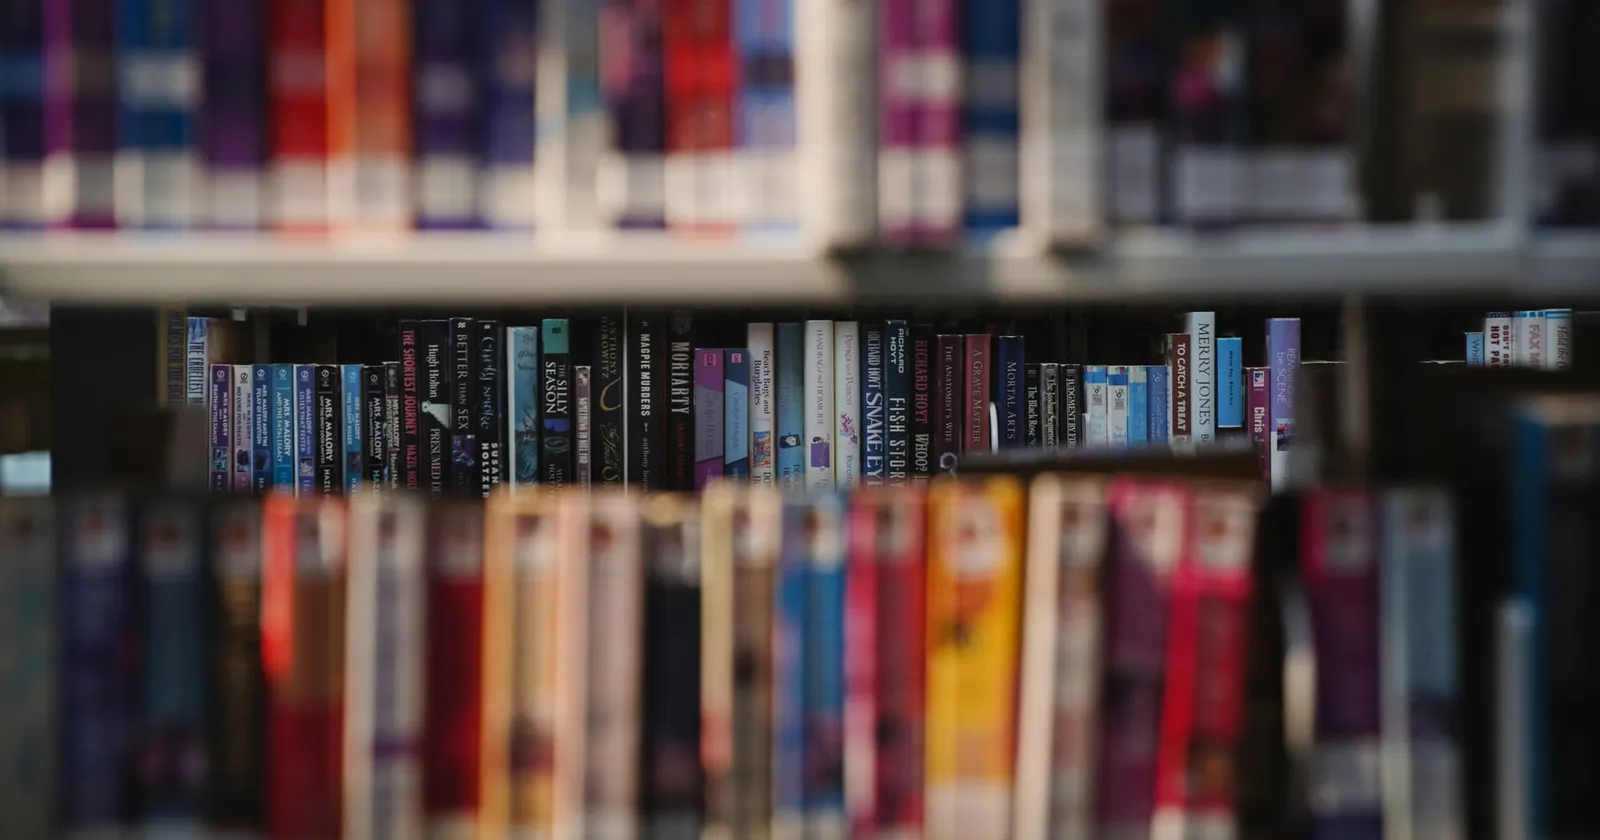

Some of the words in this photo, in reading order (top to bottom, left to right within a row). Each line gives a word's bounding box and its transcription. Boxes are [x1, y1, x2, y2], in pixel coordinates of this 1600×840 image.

[188, 341, 205, 355] THE
[402, 329, 414, 346] THE
[609, 320, 618, 376] ANTHONY
[844, 334, 854, 363] Purses
[866, 330, 881, 366] RICHARD
[890, 336, 898, 365] HOYT
[897, 327, 905, 374] RICHARD
[1177, 342, 1186, 356] TO
[1198, 322, 1210, 377] MERRY
[1490, 326, 1500, 346] HOT
[1529, 324, 1541, 350] FAX
[1557, 325, 1570, 347] Hold
[426, 344, 440, 368] Hugh
[456, 333, 469, 380] BETTER
[641, 333, 651, 370] MAGPIE
[762, 350, 771, 376] Beach
[914, 339, 928, 391] RICHARD
[945, 344, 954, 363] THE
[972, 348, 982, 357] A
[1276, 352, 1287, 365] be
[1490, 350, 1500, 365] PA
[1557, 347, 1569, 360] the
[188, 357, 204, 394] CRUELLEST
[403, 347, 416, 392] SHORTEST
[428, 369, 440, 398] Holton
[557, 363, 567, 378] THE
[670, 341, 691, 415] MORIARTY
[753, 359, 763, 406] Burglaries
[867, 366, 881, 390] HOYT
[972, 360, 983, 396] GRAVE
[1006, 361, 1017, 408] MORTAL
[1046, 378, 1056, 391] The
[1177, 357, 1187, 389] CATCH
[458, 382, 467, 405] THAN
[544, 360, 557, 415] SEASON
[556, 379, 568, 415] SILLY
[641, 371, 651, 417] MURDERS
[761, 377, 771, 398] Bags
[844, 376, 854, 406] Poison
[945, 363, 954, 419] ANATOMIST'S
[1028, 386, 1038, 399] The
[1065, 378, 1076, 422] JUDGMENT
[1177, 390, 1186, 398] A
[1276, 367, 1287, 404] SCENE
[256, 405, 262, 413] OF
[324, 398, 333, 419] MRS.
[373, 397, 382, 419] MRS.
[392, 399, 400, 417] MRS.
[404, 393, 417, 436] JOURNEY
[577, 396, 588, 431] SOMETHING
[763, 399, 771, 415] and
[815, 385, 825, 425] HOMICIDE
[914, 392, 928, 424] HOYT
[1028, 399, 1038, 418] Black
[1046, 391, 1056, 414] Joshua
[1177, 399, 1187, 431] TREAT
[1196, 379, 1211, 426] JONES
[305, 405, 313, 434] MALORY
[392, 417, 400, 448] MALORY
[457, 408, 469, 430] SEX
[865, 391, 884, 452] SNAKE
[944, 421, 954, 443] WIFE
[972, 398, 983, 443] MATTER
[1006, 410, 1017, 440] ARTS
[1028, 419, 1038, 437] Rose
[1045, 415, 1056, 446] Sequence
[1066, 422, 1076, 433] BY
[1253, 406, 1266, 433] Chris
[283, 419, 292, 457] MALORY
[324, 421, 334, 462] MALORY
[374, 420, 383, 461] MALORY
[578, 431, 588, 439] TO
[406, 444, 417, 469] HAZEL
[430, 428, 441, 480] PRESUMED
[491, 442, 499, 484] SUSAN
[641, 437, 651, 468] anthony
[914, 433, 929, 472] WHOO?
